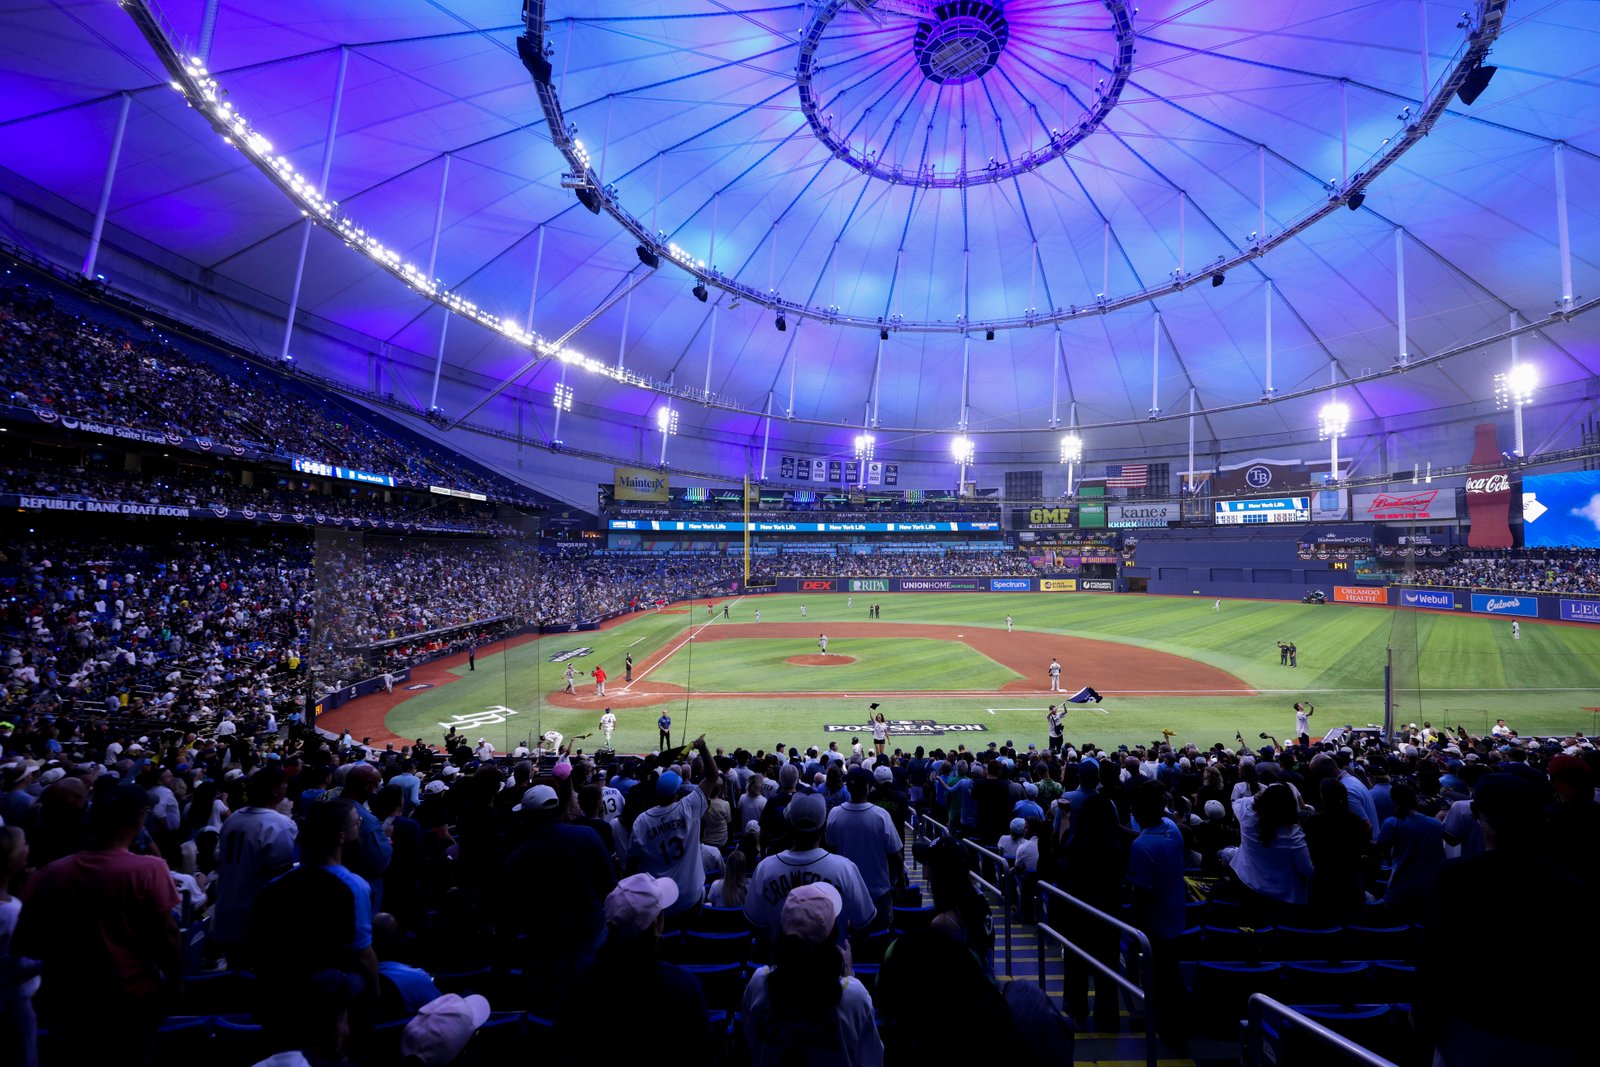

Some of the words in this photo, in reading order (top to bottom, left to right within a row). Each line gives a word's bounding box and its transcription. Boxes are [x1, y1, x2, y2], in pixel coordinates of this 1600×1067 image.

[80, 422, 113, 436] Webull
[115, 428, 140, 440] Suite
[142, 432, 166, 445] Level
[620, 476, 665, 492] MaintenX
[1466, 474, 1510, 493] Coca-Cola
[20, 497, 84, 511] REPUBLIC
[86, 501, 120, 513] BANK
[121, 503, 158, 515] DRAFT
[158, 506, 189, 517] ROOM
[1374, 498, 1430, 508] Budweiser
[1030, 508, 1070, 524] GMF
[1121, 507, 1167, 519] kanes
[803, 581, 832, 590] DEX
[862, 581, 885, 591] RIPA
[993, 581, 1023, 589] Spectrum
[1341, 588, 1380, 596] ORLANDO
[1346, 594, 1376, 602] HEALTH
[1419, 594, 1448, 605] Webull
[1487, 598, 1520, 611] Culver's
[829, 724, 985, 732] POSSEASON
[603, 798, 617, 815] 13
[647, 818, 686, 841] CAMINERO
[660, 836, 684, 865] 13
[763, 871, 842, 906] CRAWFO
